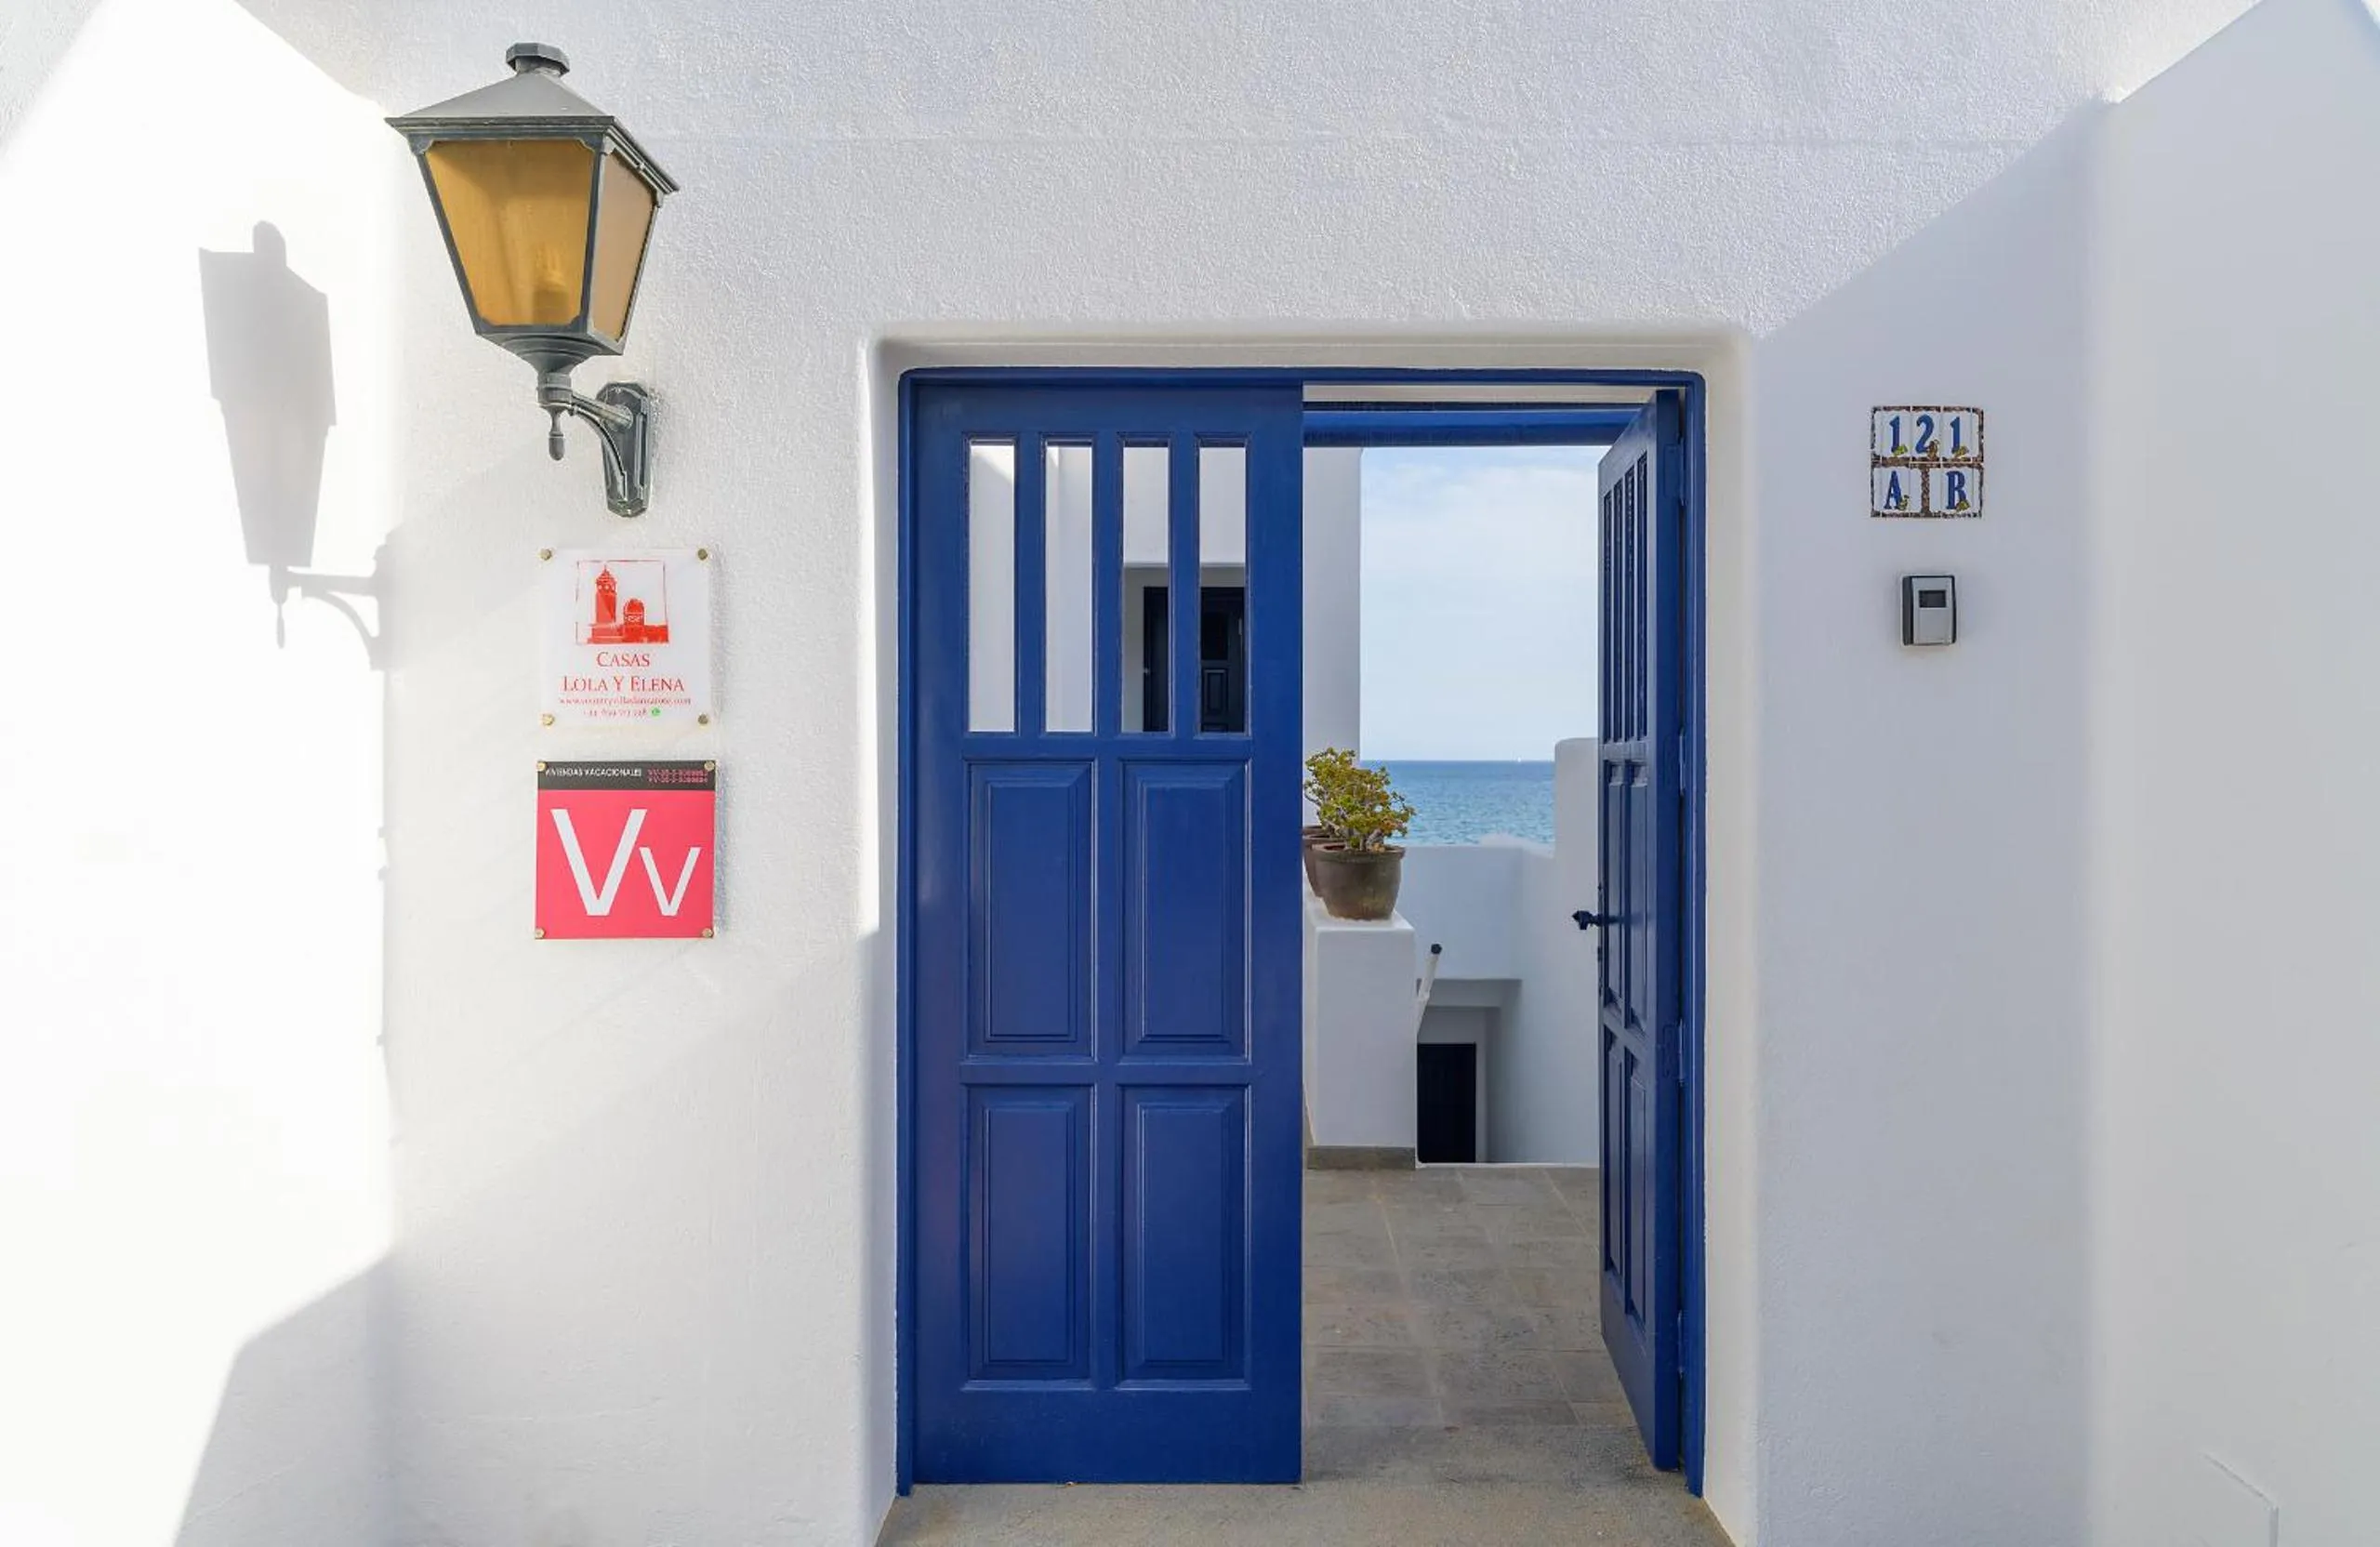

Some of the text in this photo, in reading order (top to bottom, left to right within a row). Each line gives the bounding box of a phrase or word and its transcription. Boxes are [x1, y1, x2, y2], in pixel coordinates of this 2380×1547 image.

[1888, 414, 1963, 455] 121
[1884, 469, 1904, 510] A
[596, 652, 651, 668] CASAS
[563, 675, 684, 692] LOLA Y ELENA
